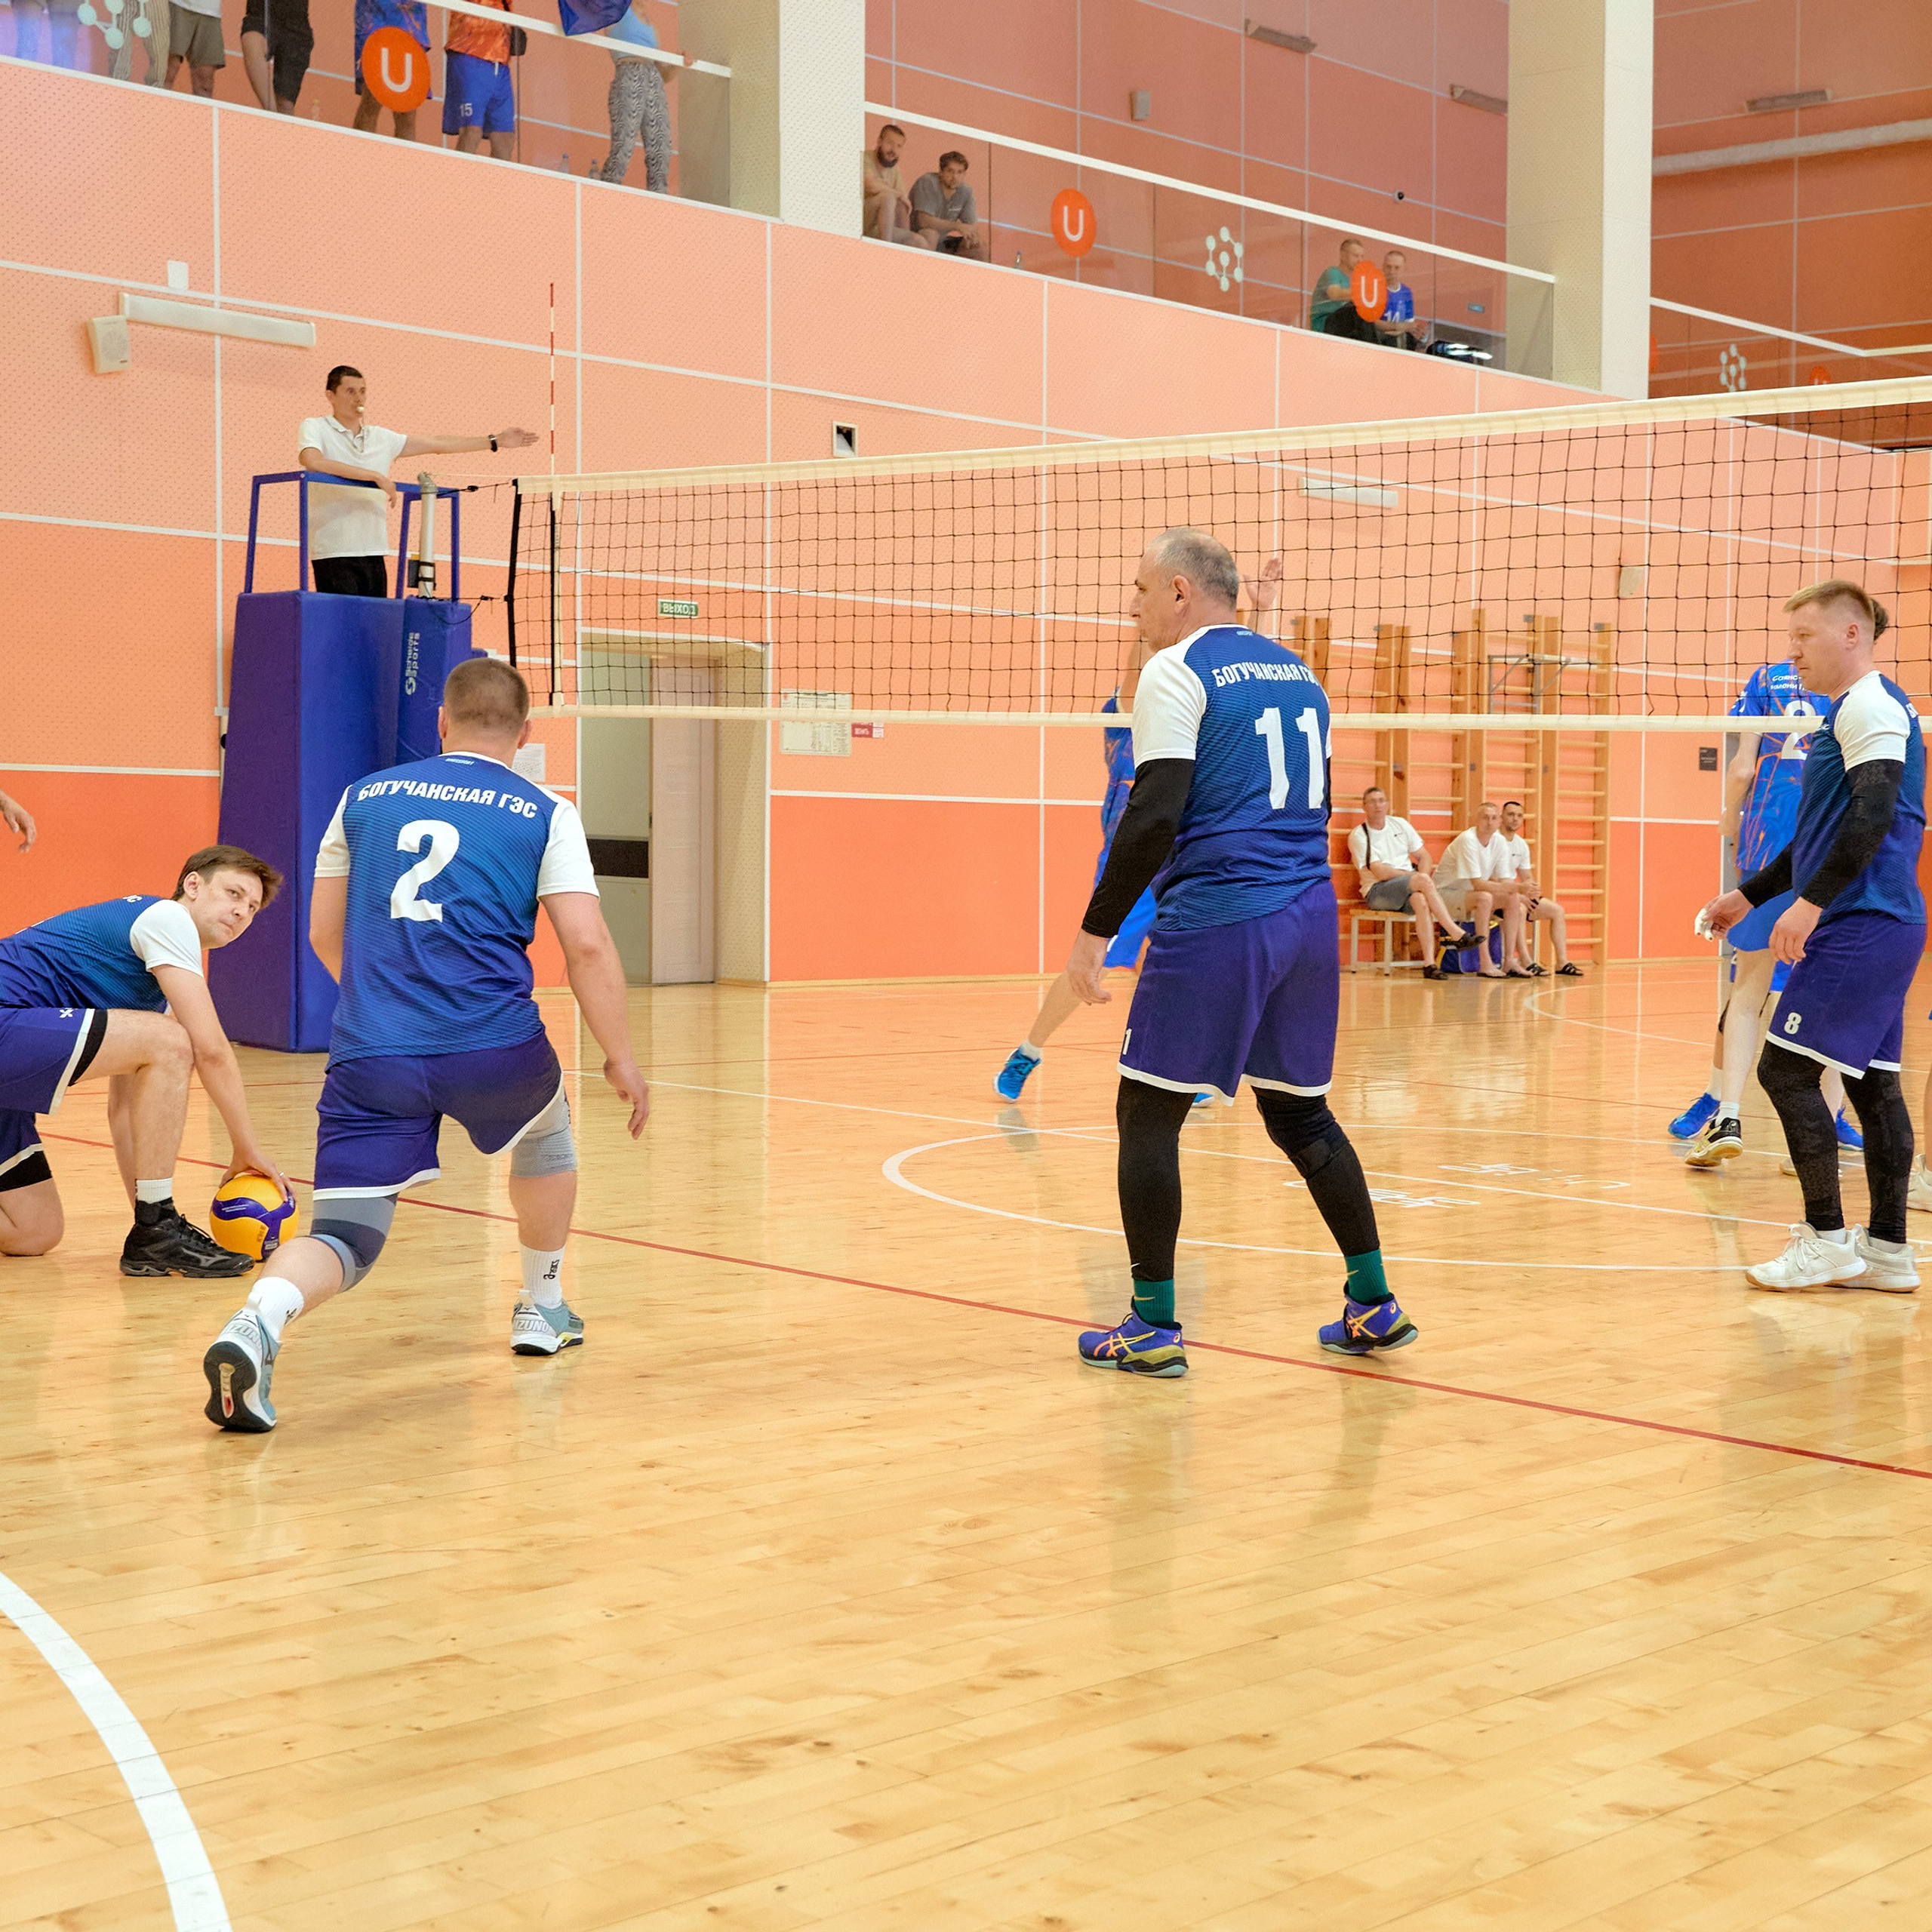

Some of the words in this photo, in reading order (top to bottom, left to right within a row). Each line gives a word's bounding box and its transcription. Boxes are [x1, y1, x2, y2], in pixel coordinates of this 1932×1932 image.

[381, 48, 412, 93] U
[460, 103, 473, 116] 15
[1063, 205, 1084, 242] U
[1361, 275, 1378, 309] U
[1212, 662, 1303, 688] БОГУЧАНСКАЯ
[1254, 707, 1324, 810] 11
[356, 780, 496, 805] БОГУЧАНСКАЯ
[498, 794, 538, 819] ГЭС
[390, 820, 460, 923] 2
[1783, 1012, 1802, 1035] 8
[514, 1319, 549, 1333] IZUNO
